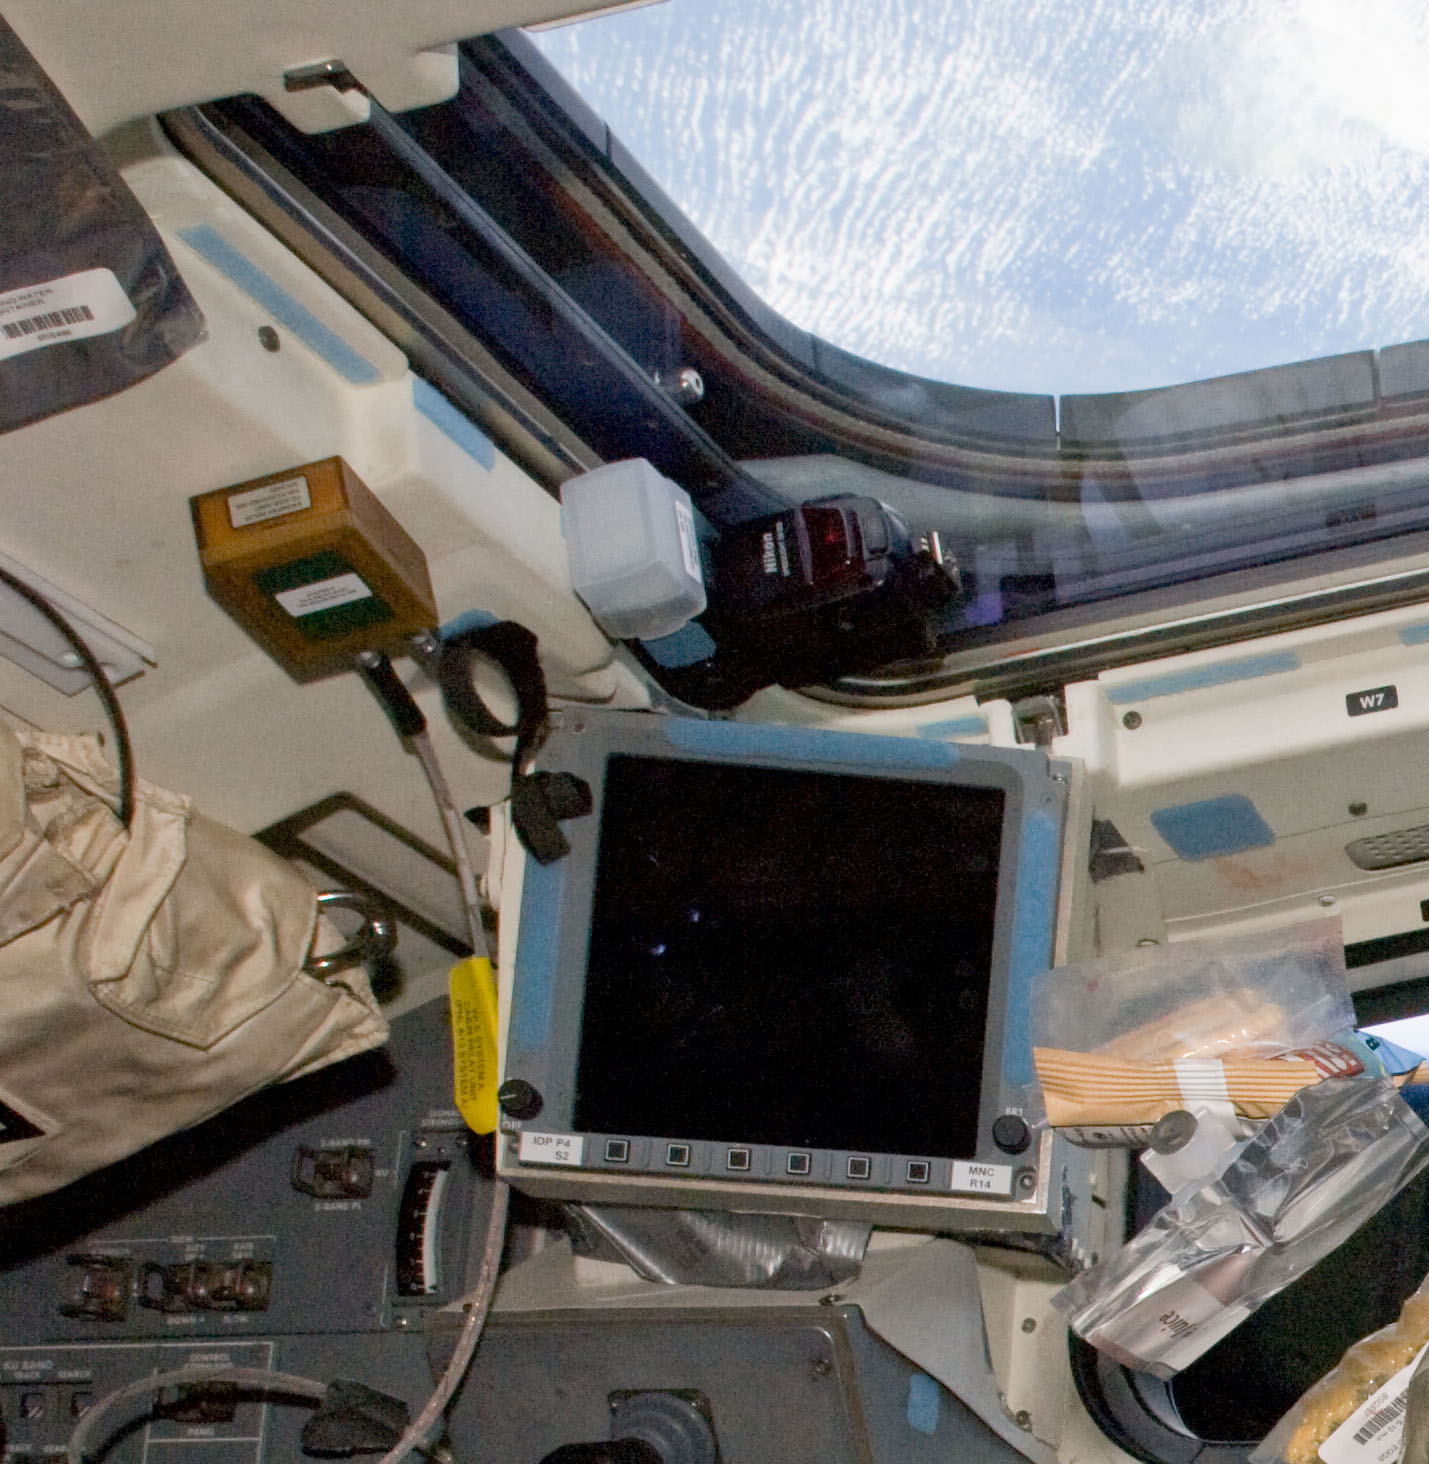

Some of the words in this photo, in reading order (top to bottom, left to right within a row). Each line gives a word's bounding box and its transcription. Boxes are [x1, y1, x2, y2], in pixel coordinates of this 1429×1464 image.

[763, 533, 777, 573] Nikon
[1360, 693, 1385, 709] W7
[557, 1136, 571, 1147] P4
[555, 1150, 569, 1161] S2
[967, 1164, 995, 1178] MNC
[969, 1178, 992, 1190] R14
